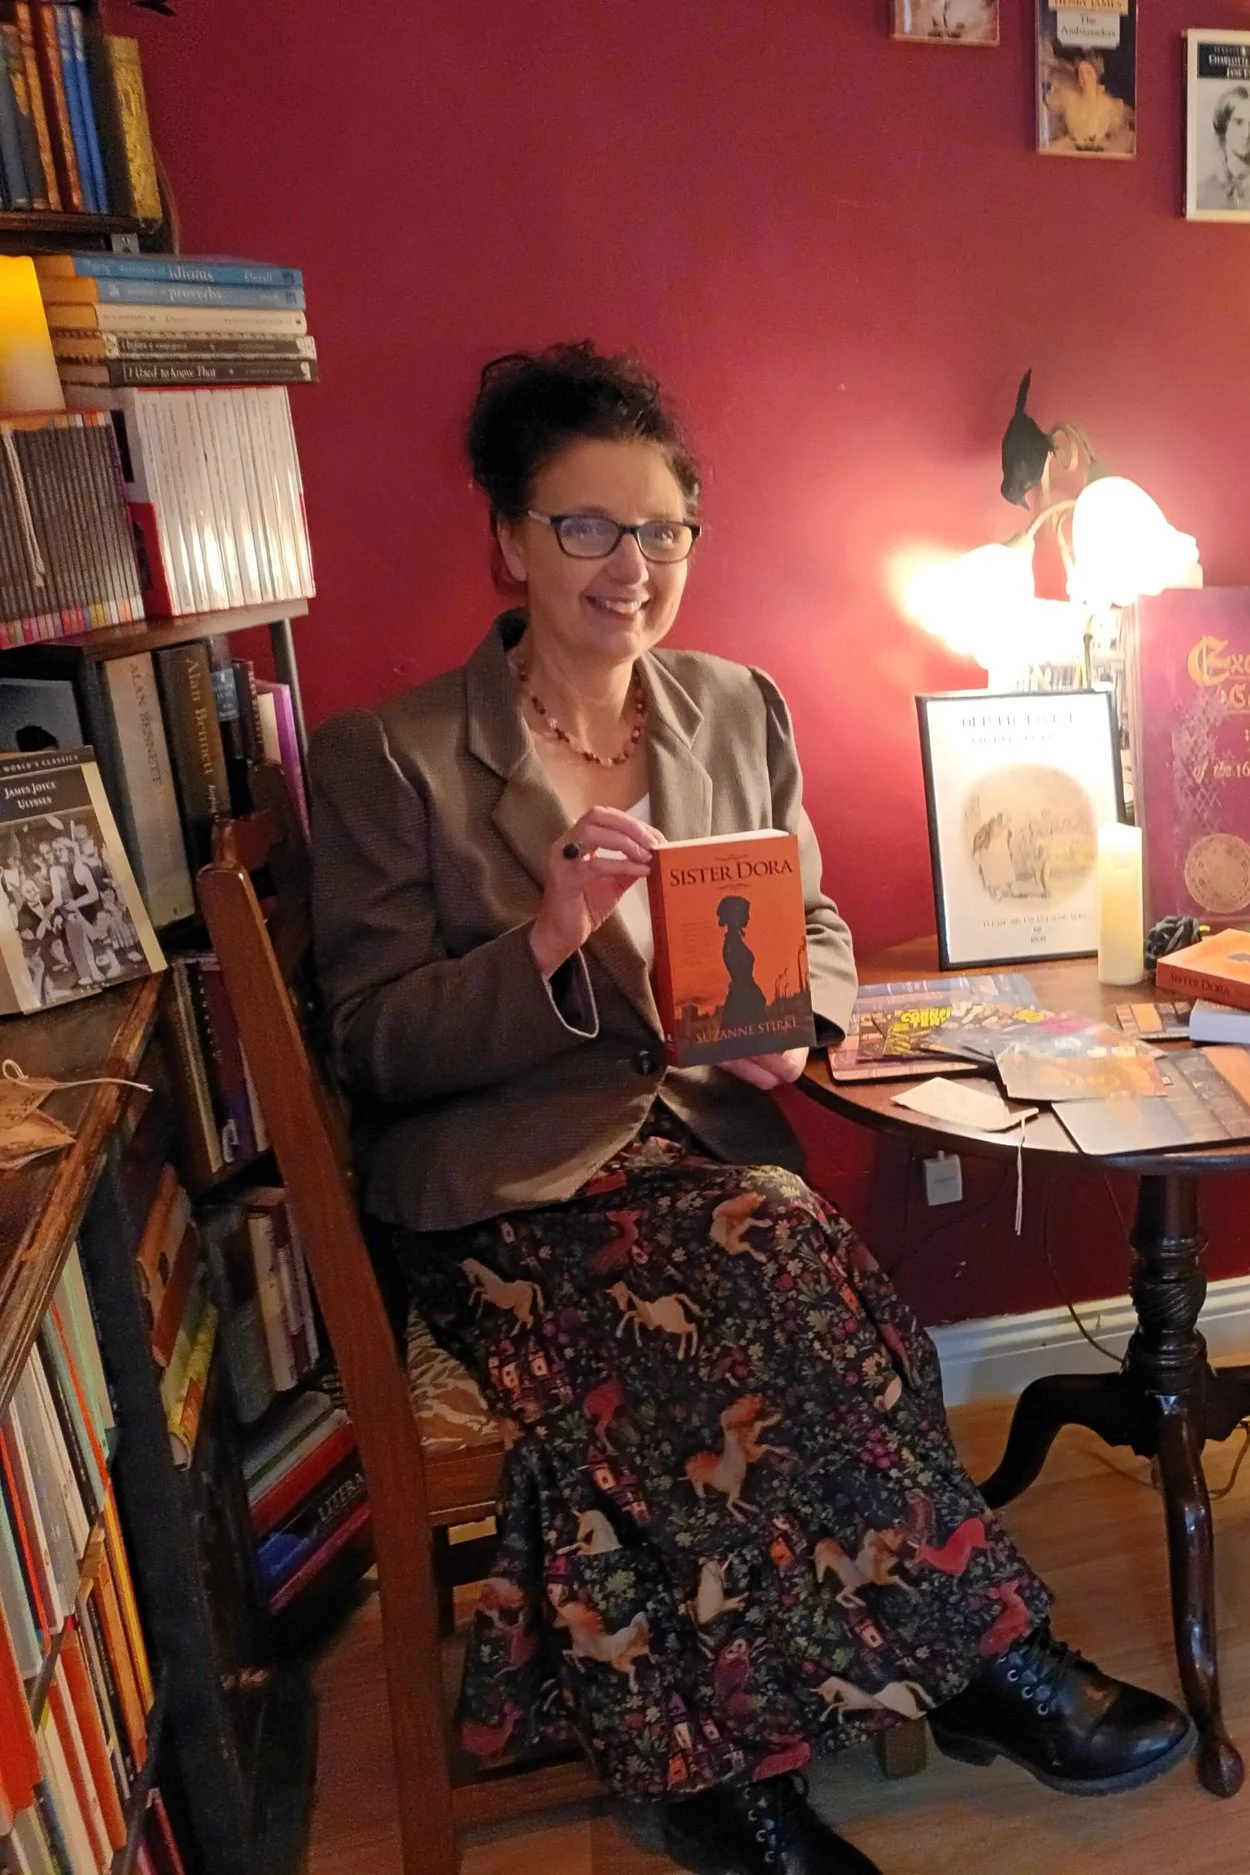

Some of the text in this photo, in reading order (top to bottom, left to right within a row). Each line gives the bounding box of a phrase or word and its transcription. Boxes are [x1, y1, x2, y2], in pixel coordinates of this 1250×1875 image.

[130, 663, 162, 784] ALAN BENNETT
[186, 658, 201, 701] Alan
[195, 708, 214, 774] Bennett
[41, 754, 78, 767] CLASSICS
[4, 781, 57, 800] JAMES JOYCE
[17, 796, 52, 810] ULYSSES
[670, 858, 793, 887] SISTER DORA
[1169, 972, 1231, 996] SISTER DORA
[696, 1023, 756, 1044] SUZANNE
